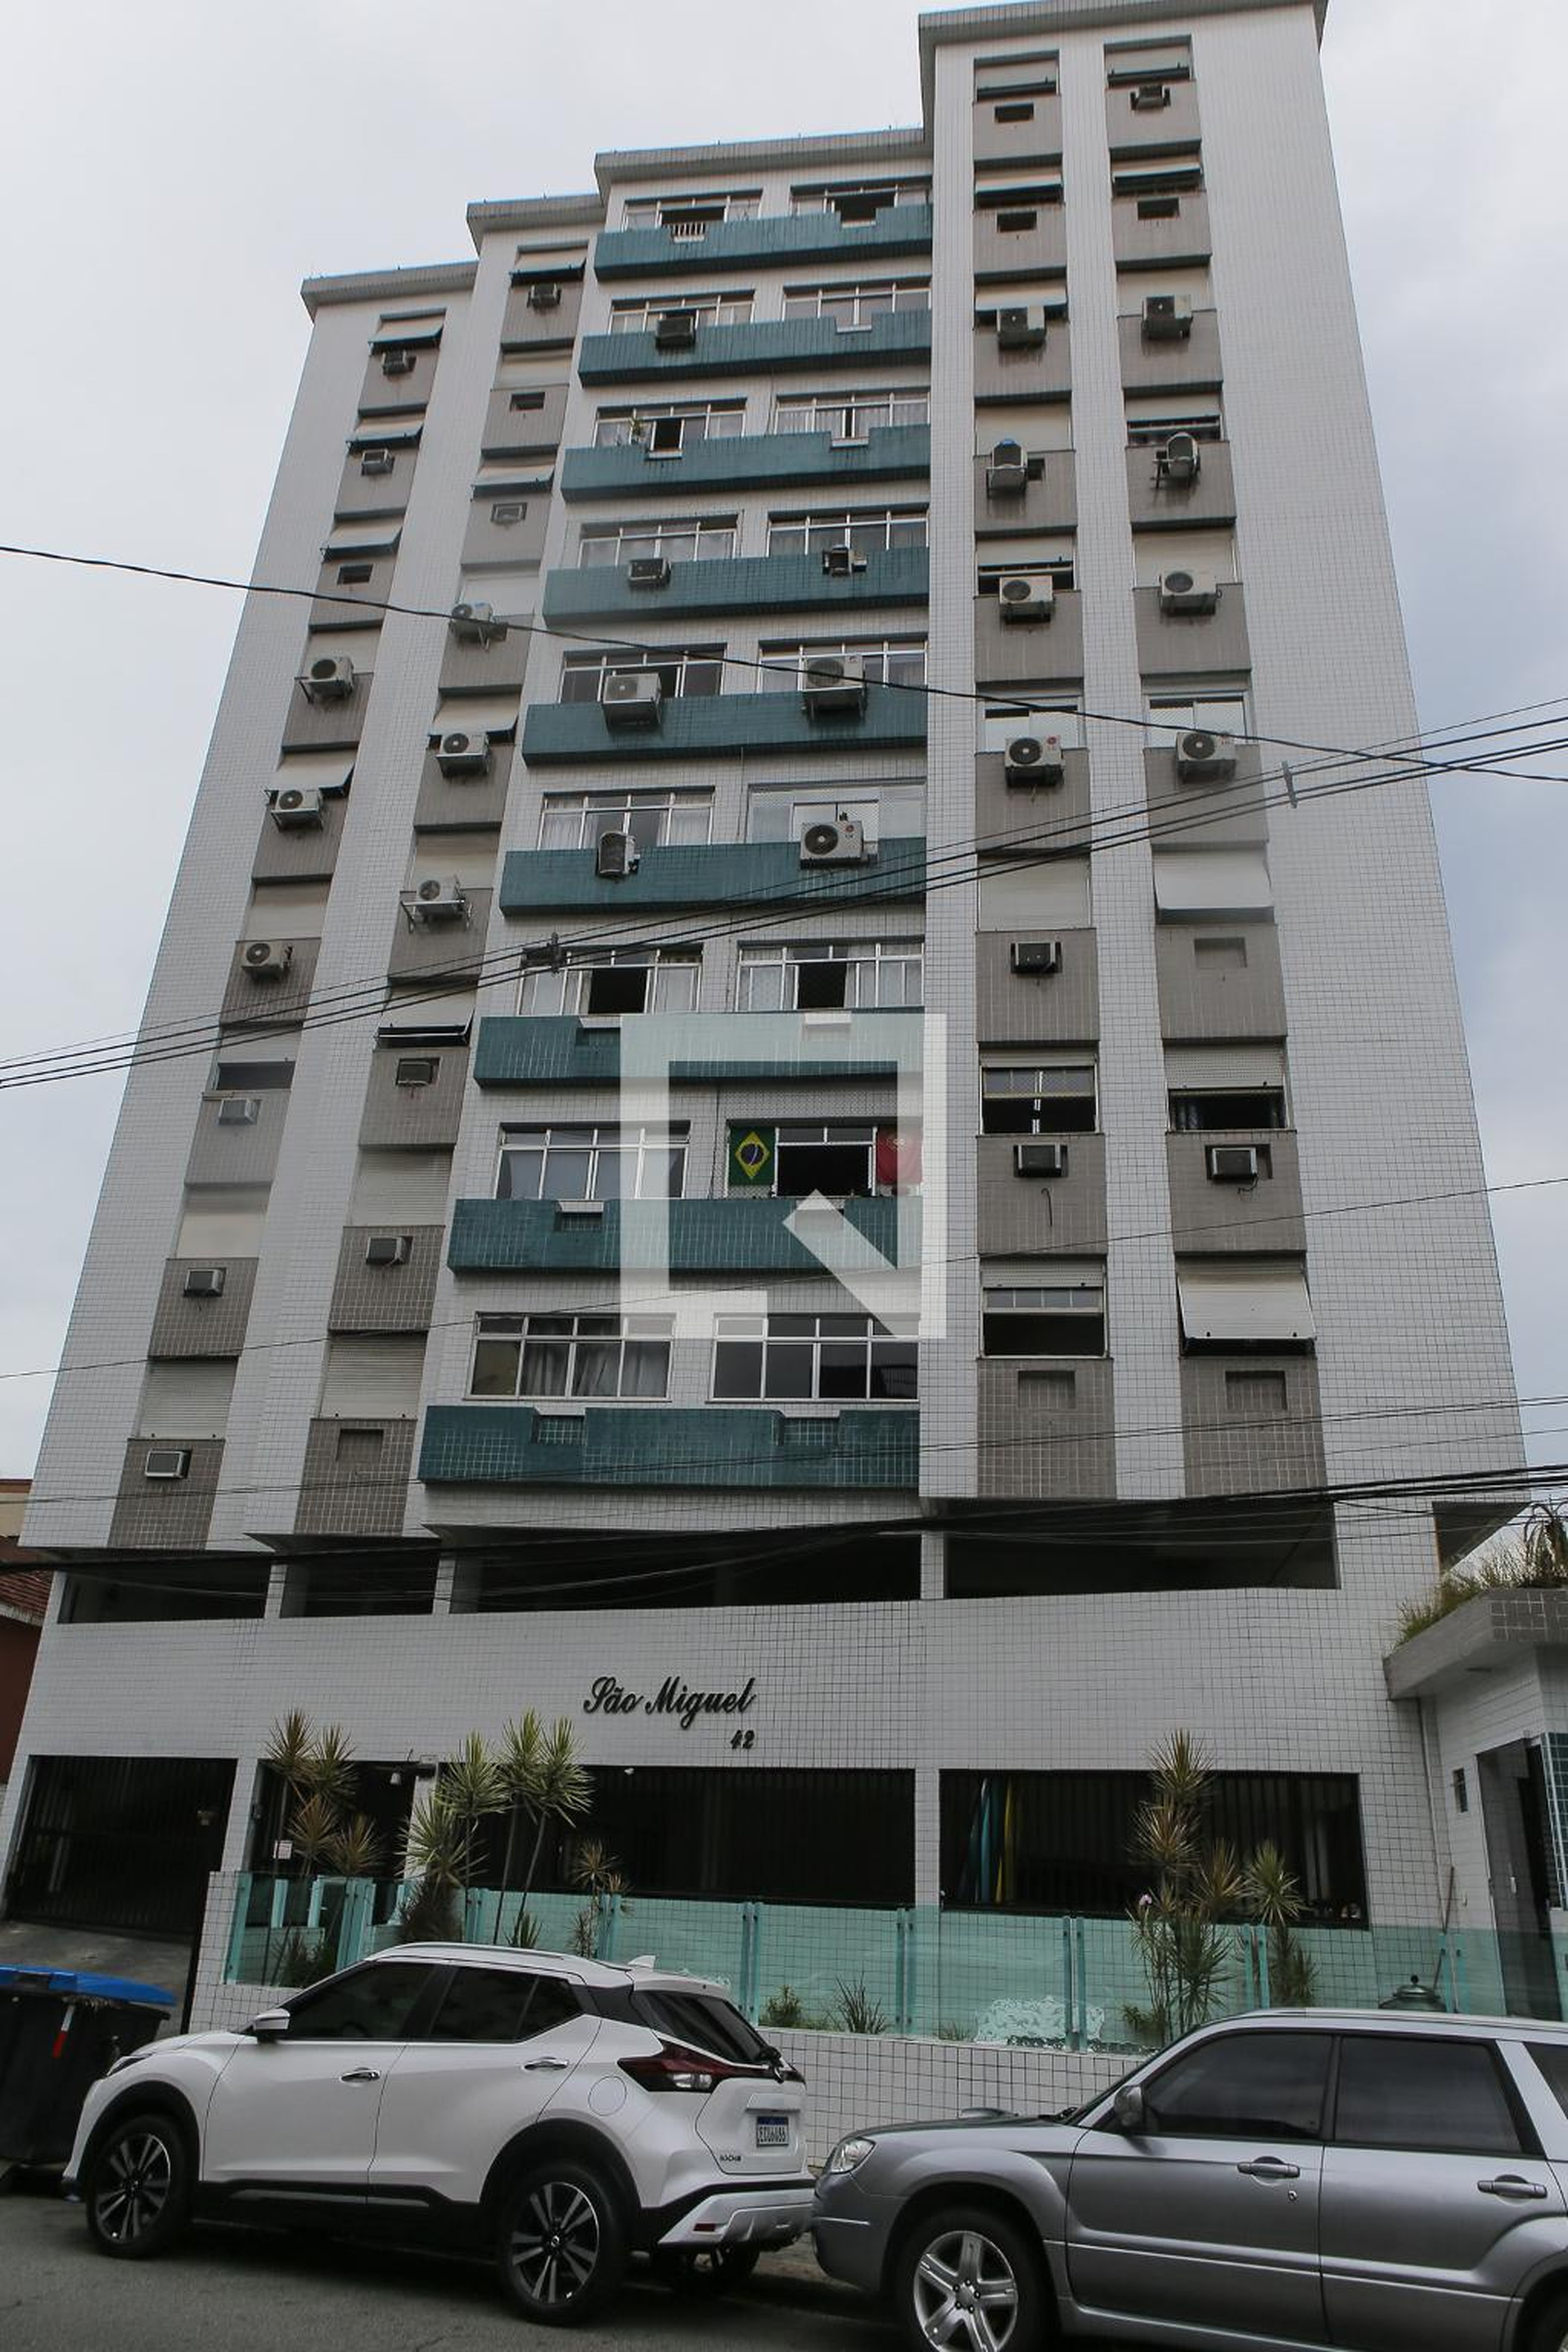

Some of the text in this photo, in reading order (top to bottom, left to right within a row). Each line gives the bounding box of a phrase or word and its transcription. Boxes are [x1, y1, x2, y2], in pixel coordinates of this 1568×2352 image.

[583, 1676, 757, 1730] São Miguel
[730, 1729, 755, 1749] 42
